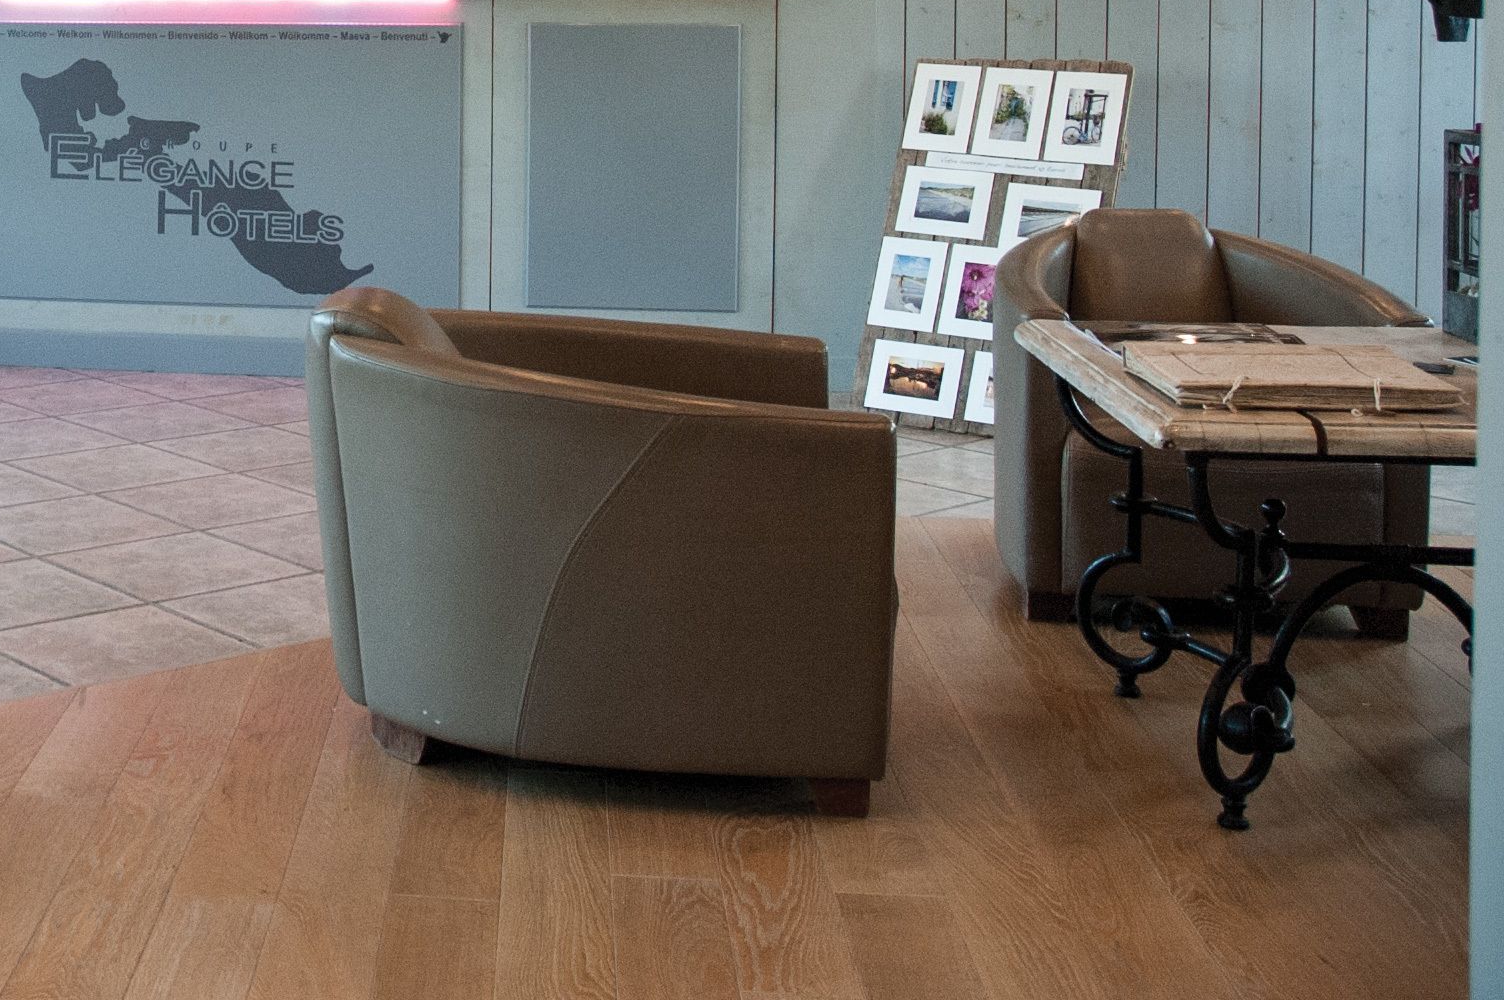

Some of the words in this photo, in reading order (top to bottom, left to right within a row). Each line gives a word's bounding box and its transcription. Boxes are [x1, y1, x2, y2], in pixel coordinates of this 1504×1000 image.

[7, 28, 47, 39] Welcome
[56, 29, 93, 39] Welkom
[102, 29, 158, 40] Willkommen
[167, 30, 219, 40] Bienvenido
[340, 31, 371, 41] Maeva
[380, 31, 429, 41] Benvenuti
[139, 137, 279, 154] GROUPE
[156, 189, 345, 245] HÔTELS
